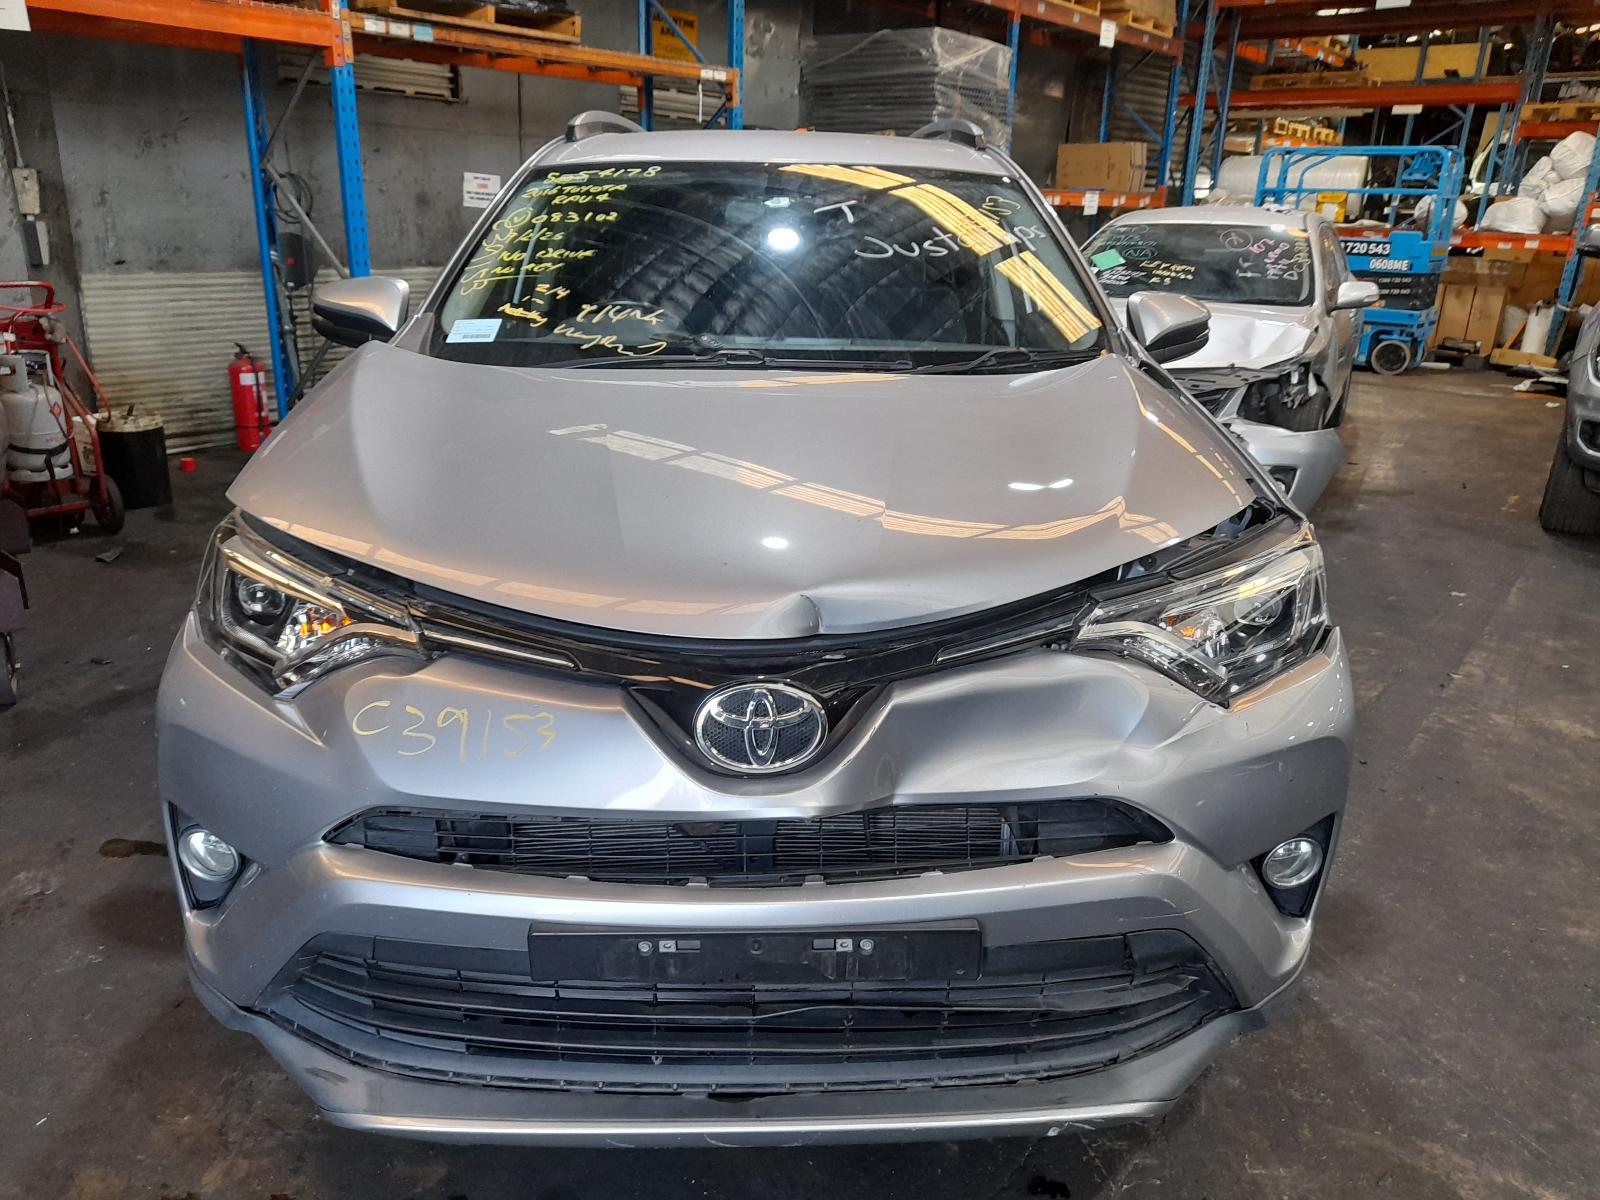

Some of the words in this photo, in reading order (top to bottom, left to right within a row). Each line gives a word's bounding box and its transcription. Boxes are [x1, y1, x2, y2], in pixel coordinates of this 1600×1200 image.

[561, 184, 628, 194] TOYOTA
[531, 212, 618, 224] 083102
[854, 227, 959, 258] Just
[1369, 259, 1409, 271] 0608ME
[352, 700, 556, 764] C39153
